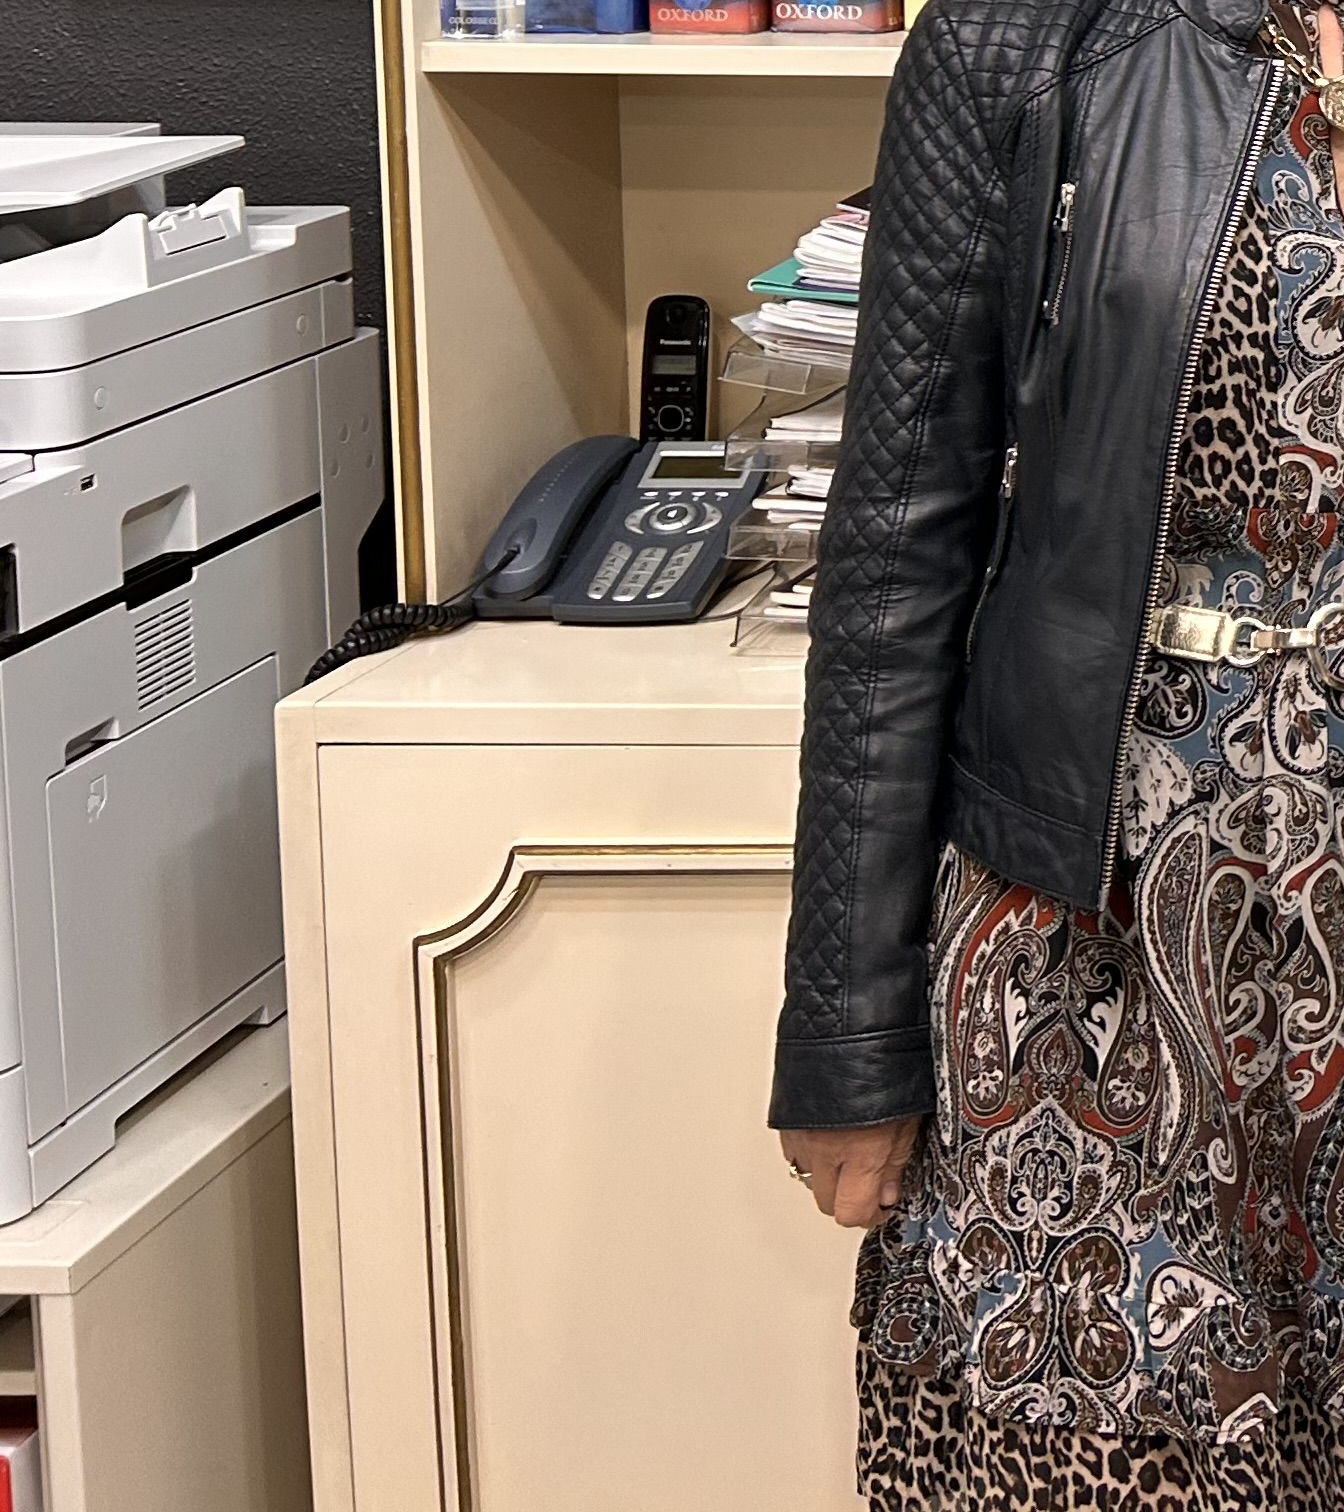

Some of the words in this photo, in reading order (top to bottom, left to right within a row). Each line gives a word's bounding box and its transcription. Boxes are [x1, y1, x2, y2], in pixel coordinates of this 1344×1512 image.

[658, 9, 728, 22] OXFORD
[776, 3, 862, 20] OXFORD
[659, 338, 692, 346] Panasonic
